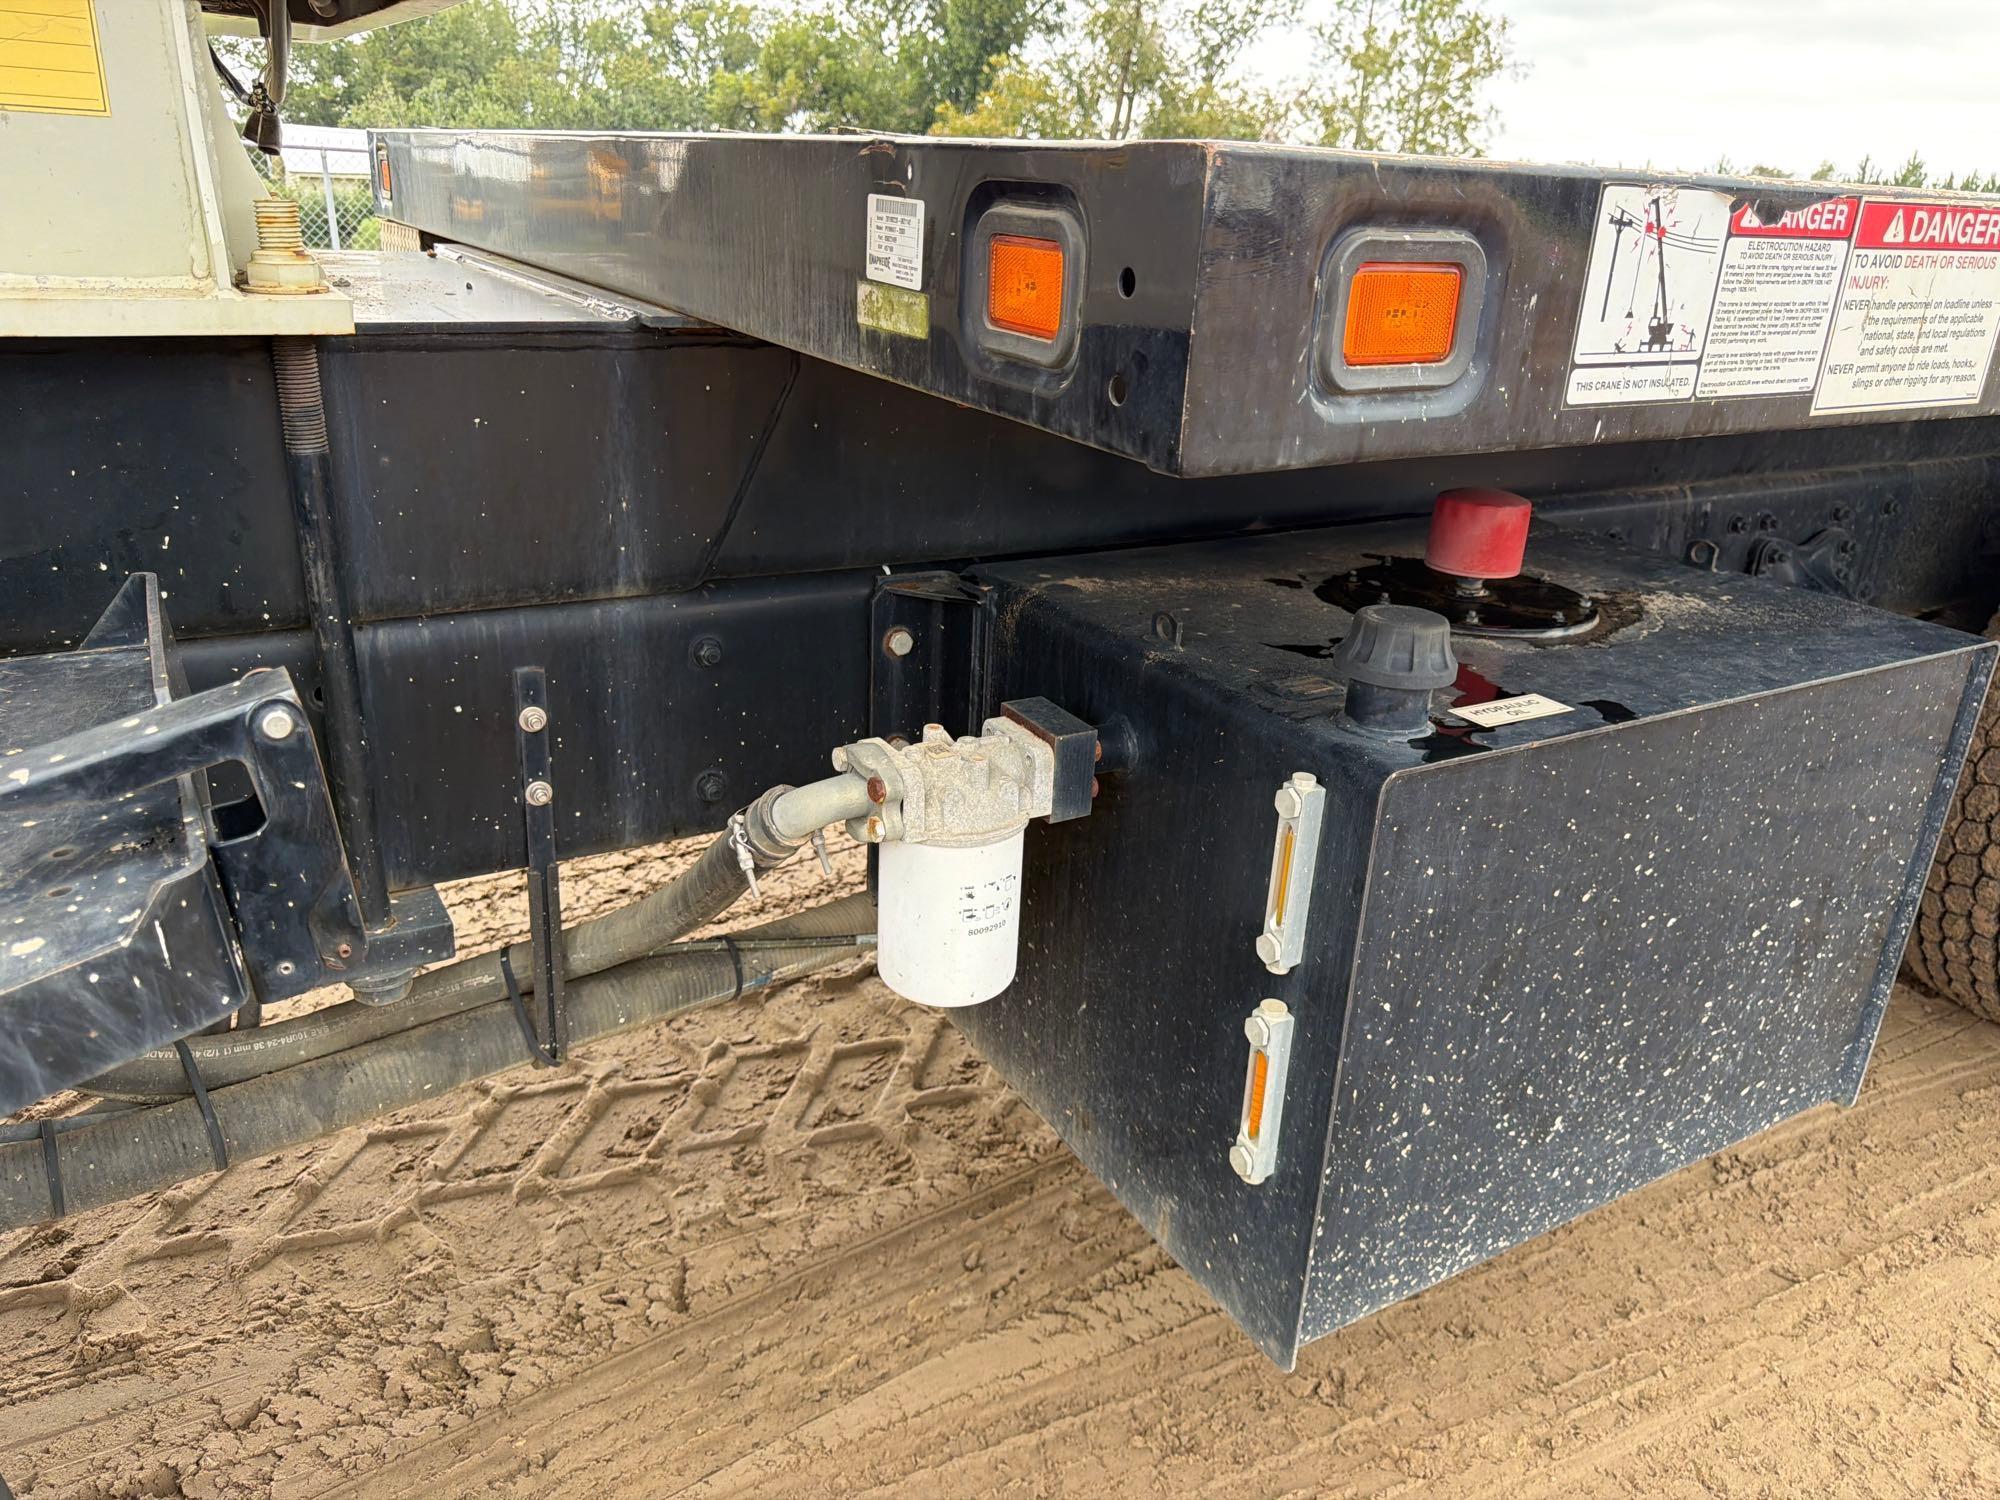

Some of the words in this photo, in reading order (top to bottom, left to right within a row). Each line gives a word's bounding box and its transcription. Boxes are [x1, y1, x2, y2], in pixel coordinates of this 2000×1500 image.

[1764, 203, 1848, 230] ANGER
[1909, 211, 2000, 245] DANGER
[1748, 241, 1803, 252] ELECTROCUTION
[1804, 242, 1832, 252] HAZARD
[1855, 254, 1868, 268] TO
[1870, 254, 1902, 268] AVOID
[1903, 256, 1938, 269] DEATH
[1940, 256, 1954, 269] OR
[1956, 256, 1997, 270] SERIOUS
[1849, 275, 1889, 290] INJURY:
[1843, 300, 1871, 310] NEVER
[1872, 300, 1896, 310] handle
[1897, 299, 1933, 312] personnel
[1934, 302, 1943, 310] on
[1944, 299, 1970, 310] loadline
[1971, 299, 1993, 309] unless
[1868, 316, 1880, 325] the
[1881, 315, 1928, 327] requirements
[1929, 314, 1938, 324] of
[1938, 314, 1949, 324] the
[1950, 313, 1984, 326] applicable
[1864, 330, 1894, 342] national,
[1896, 330, 1915, 341] state,
[1932, 327, 1949, 339] local
[1949, 327, 1986, 340] regulations
[1860, 345, 1875, 356] and
[1875, 345, 1897, 357] safety
[1899, 344, 1920, 354] codes
[1933, 343, 1948, 353] met.
[1827, 364, 1854, 375] NEVER
[1855, 363, 1880, 376] permit
[1881, 364, 1906, 374] anyone
[1907, 362, 1915, 371] to
[1916, 360, 1930, 370] ride
[1930, 360, 1951, 371] loads,
[1576, 382, 1593, 392] THIS
[1595, 380, 1621, 390] CRANE
[1623, 380, 1631, 389] IS
[1632, 379, 1648, 389] NOT
[1649, 377, 1690, 388] INSULATED.
[1852, 378, 1874, 390] slings
[1875, 379, 1883, 388] or
[1884, 377, 1904, 387] other
[1904, 375, 1928, 387] rigging
[1928, 374, 1940, 384] for
[1940, 374, 1953, 385] any
[1953, 374, 1977, 383] reason.
[1469, 699, 1540, 716] HYDRAULIC
[968, 919, 1006, 936] 80092910
[253, 1042, 265, 1051] 38
[267, 1030, 309, 1050] 100R4-24
[233, 1044, 251, 1054] mm
